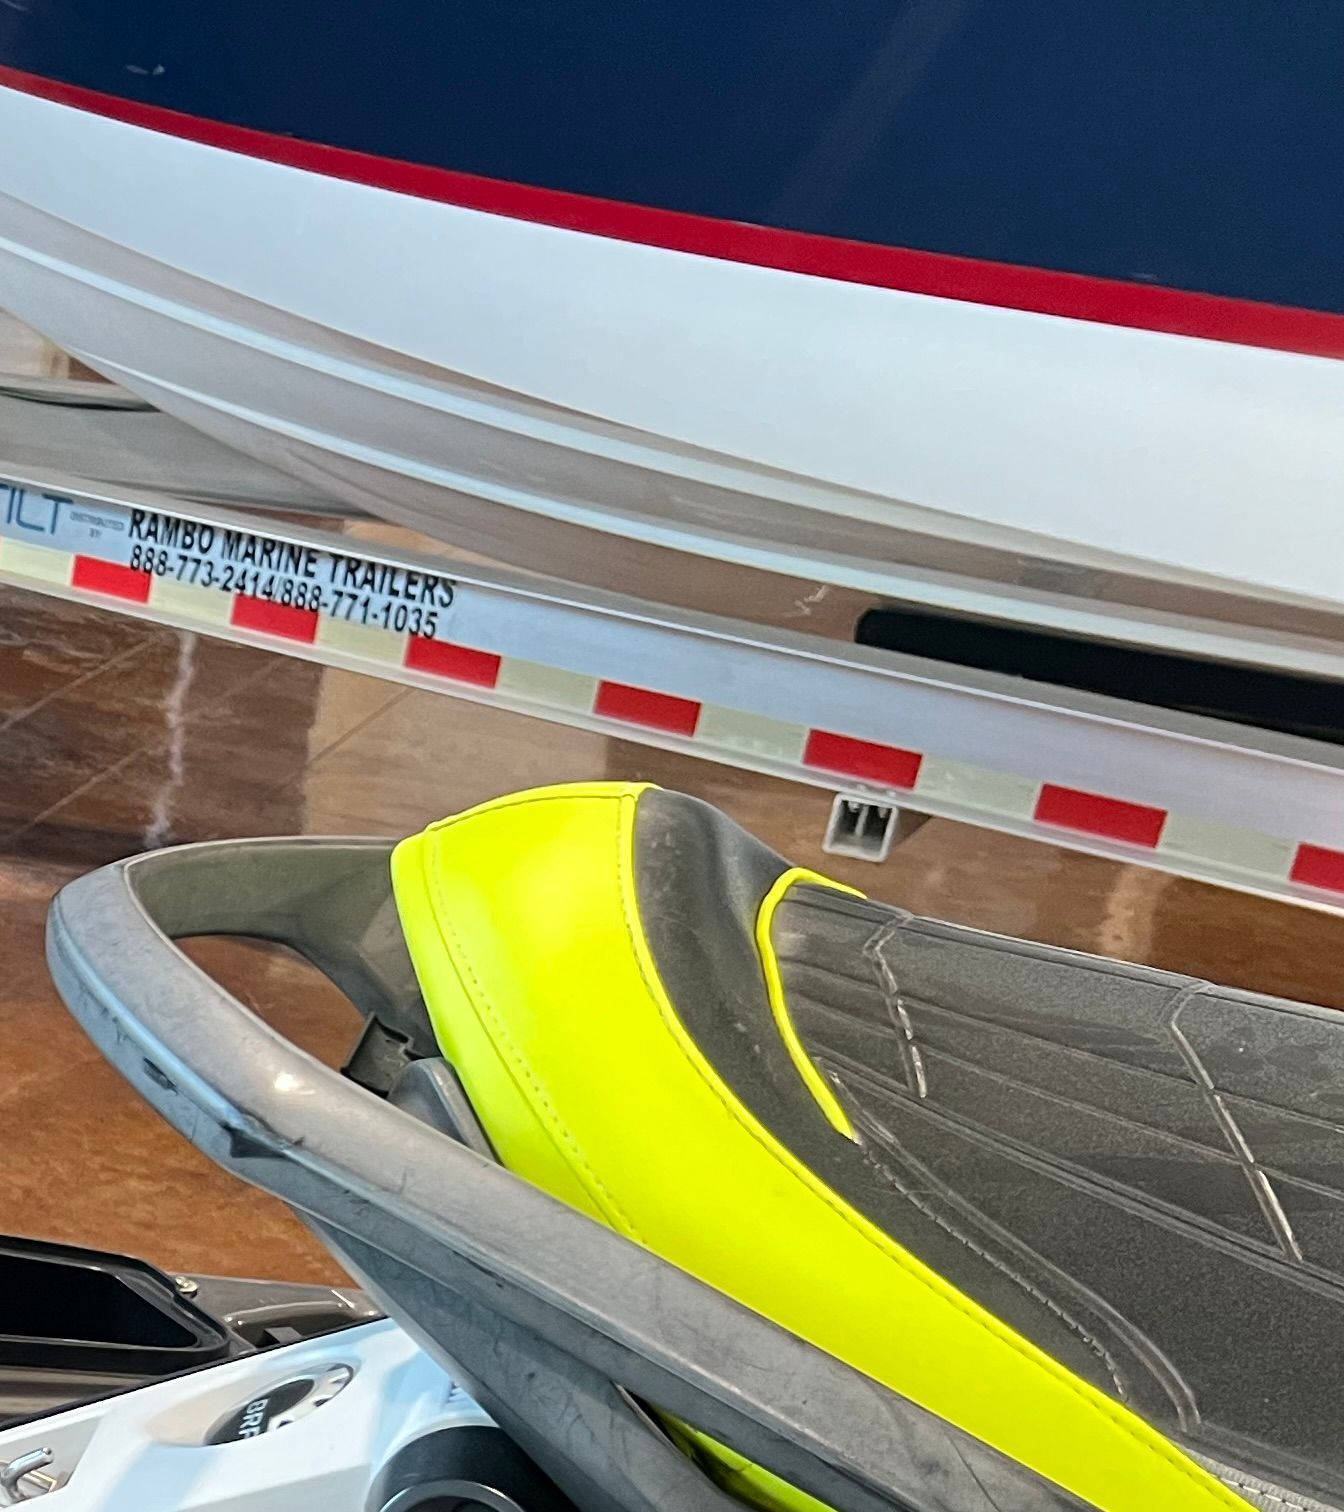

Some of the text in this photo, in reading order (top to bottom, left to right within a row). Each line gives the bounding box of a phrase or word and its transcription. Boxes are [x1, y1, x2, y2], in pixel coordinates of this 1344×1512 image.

[128, 508, 213, 553] RAMBO
[220, 529, 317, 577] MARINE
[328, 553, 458, 608] TRAILERS
